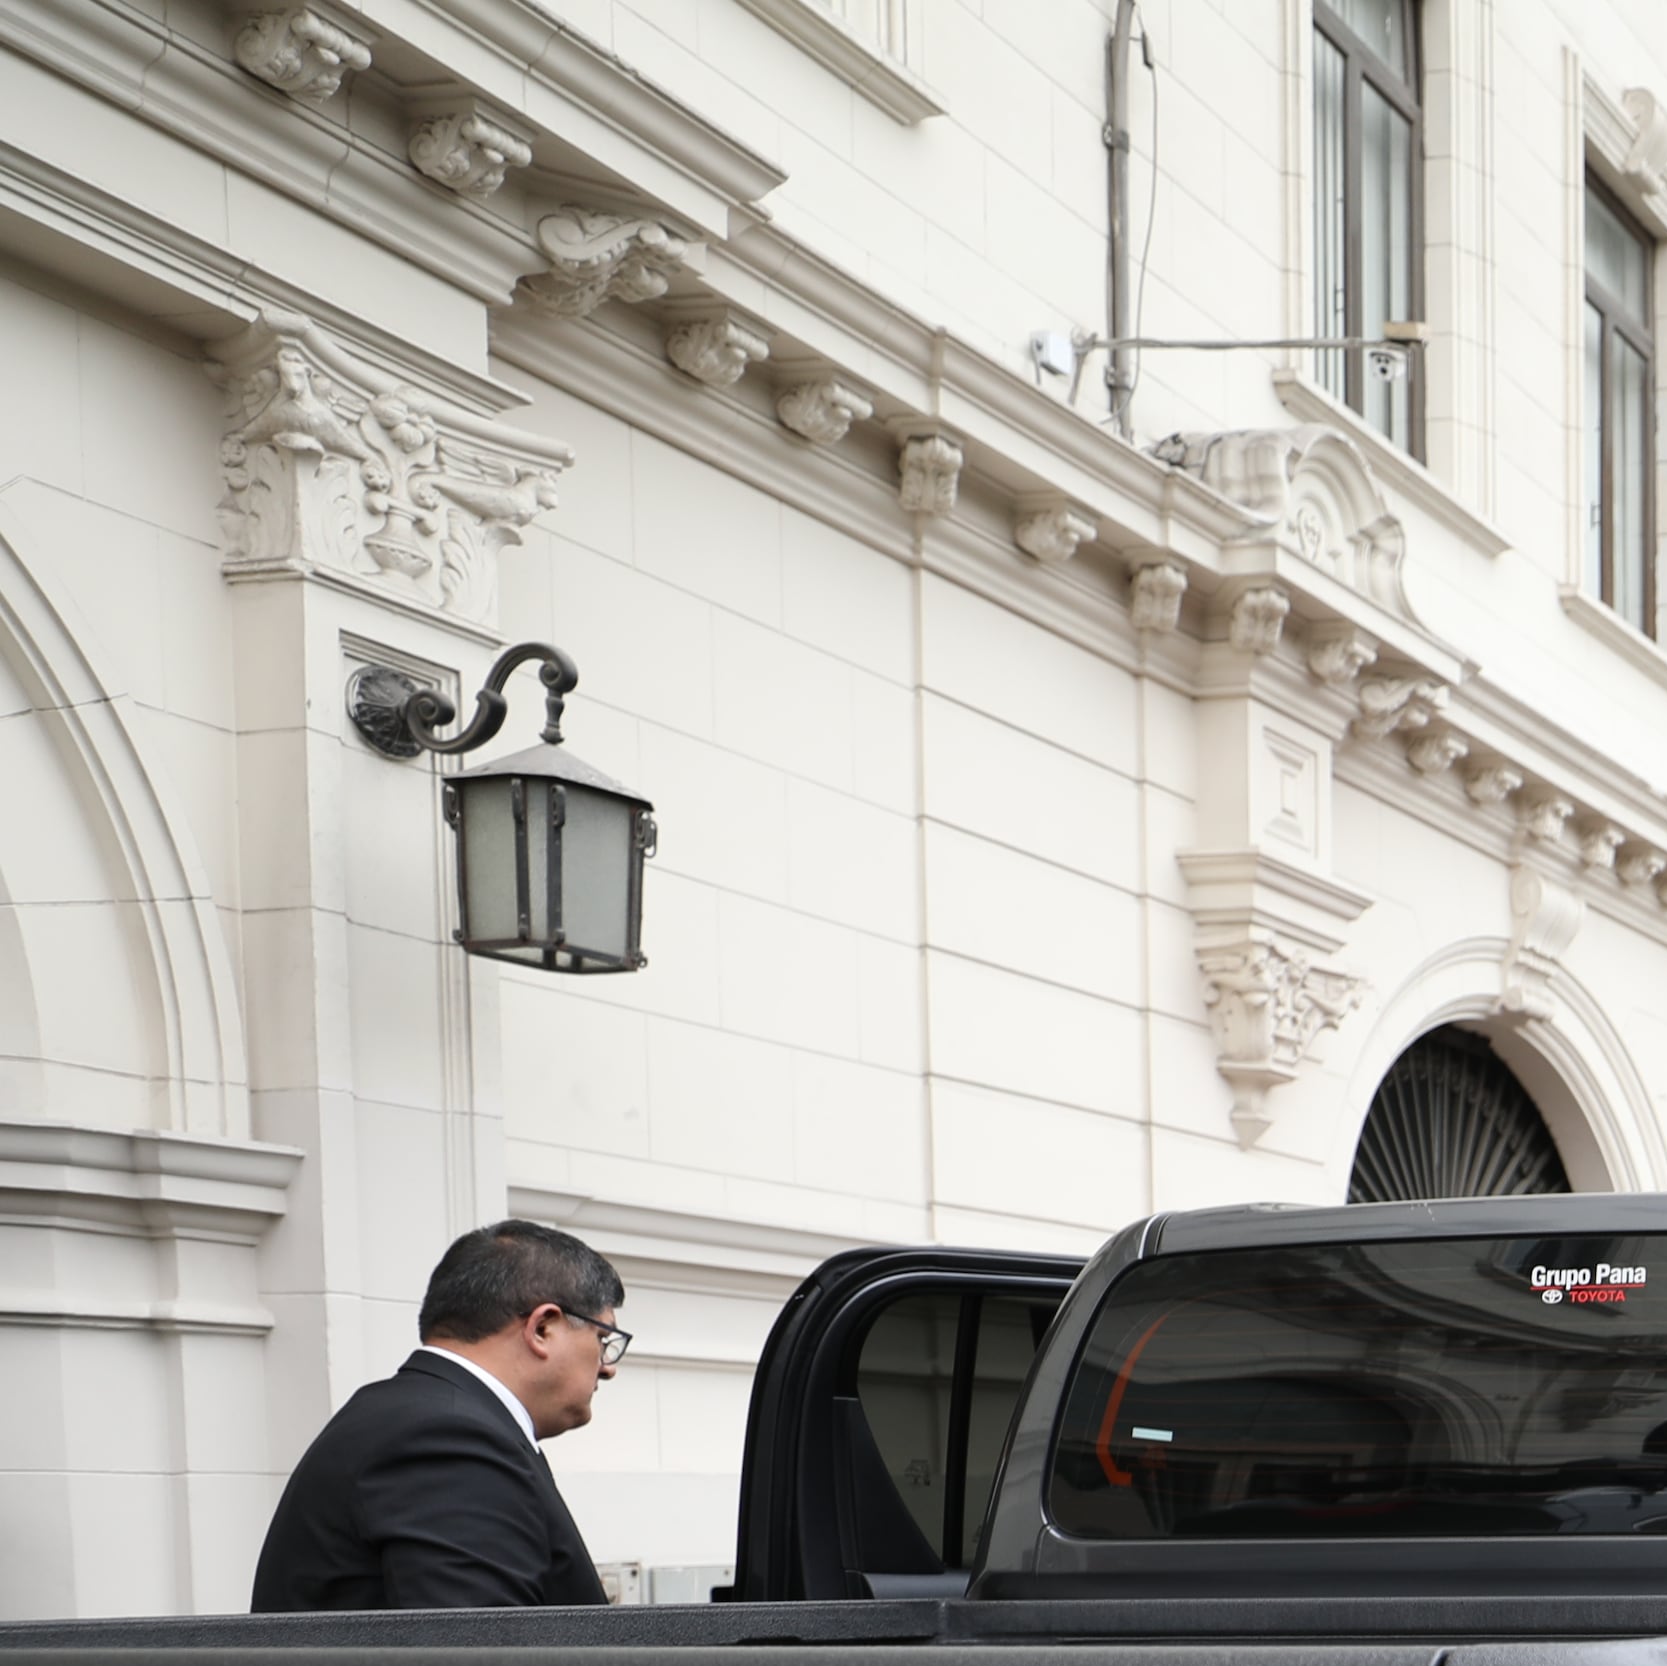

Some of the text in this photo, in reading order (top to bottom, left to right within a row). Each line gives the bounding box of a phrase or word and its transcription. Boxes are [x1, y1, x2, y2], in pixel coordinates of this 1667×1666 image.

[1531, 1263, 1646, 1291] Grupo Pana
[1569, 1290, 1626, 1303] TOYOTA
